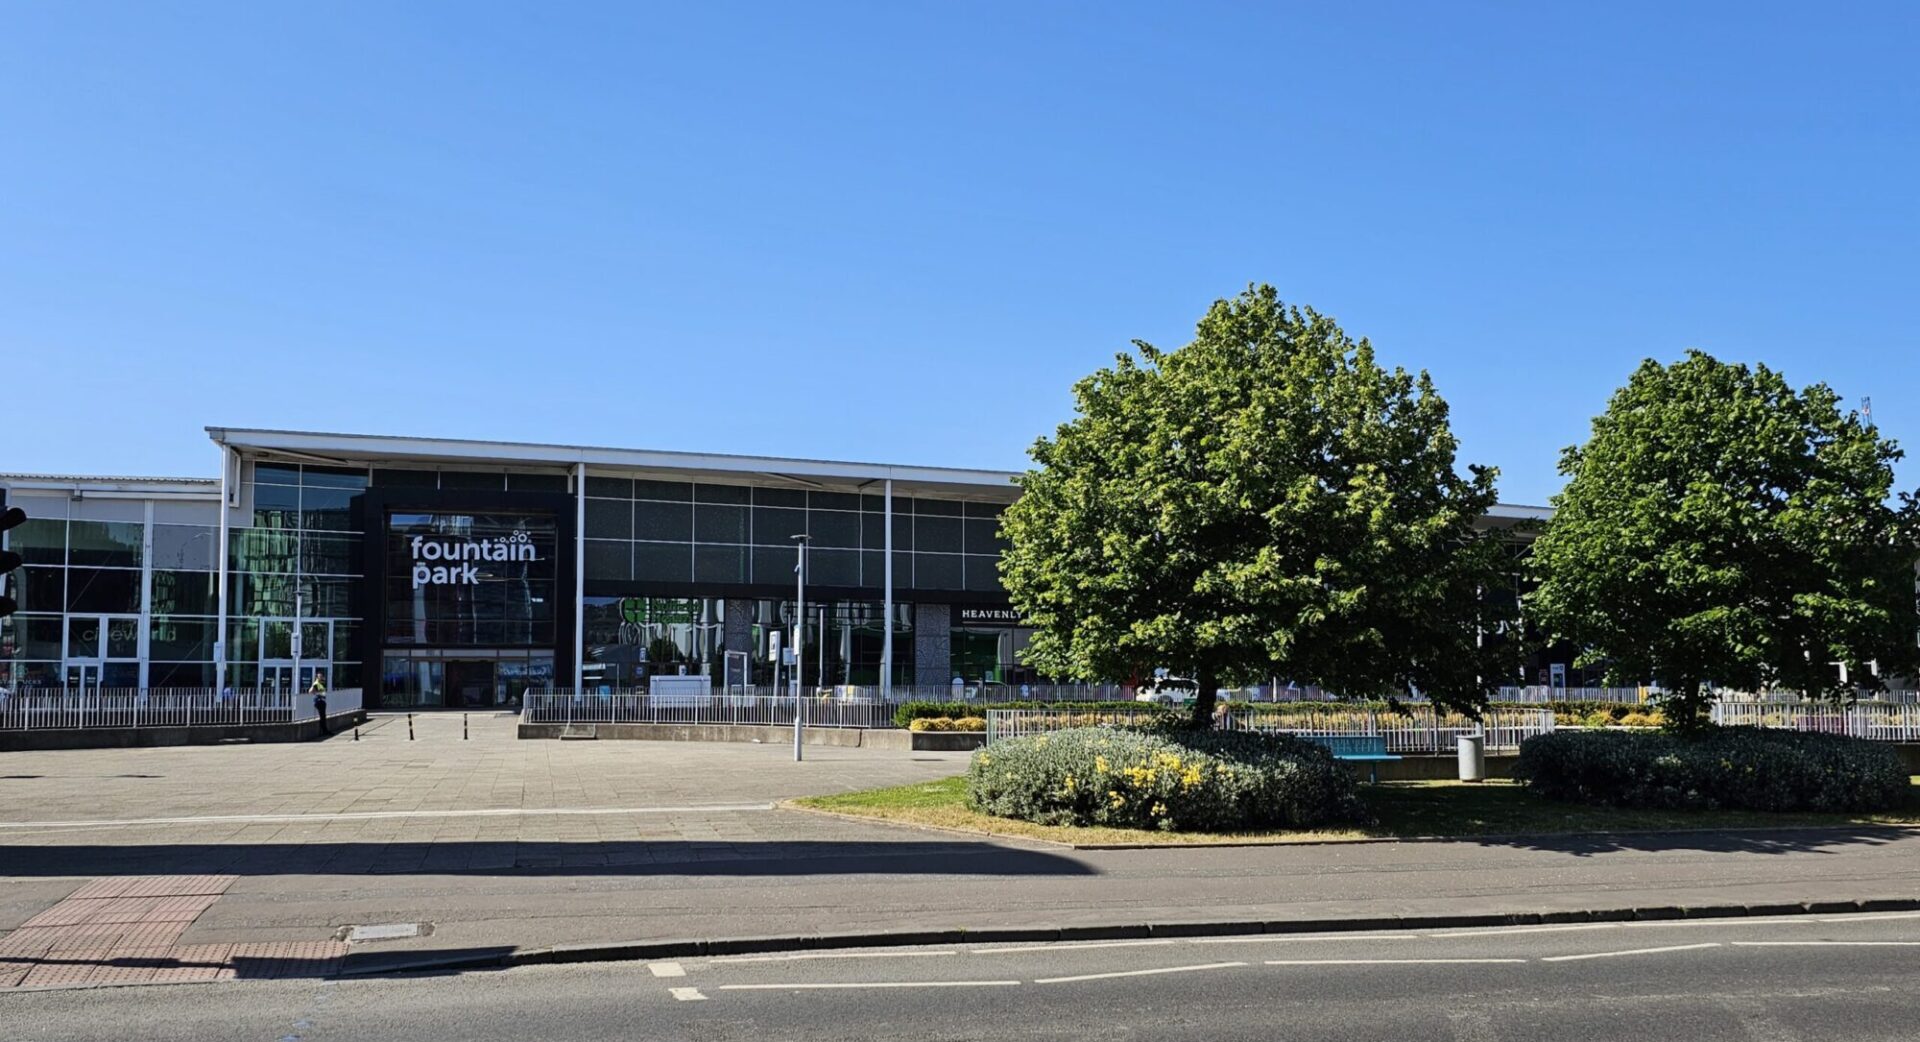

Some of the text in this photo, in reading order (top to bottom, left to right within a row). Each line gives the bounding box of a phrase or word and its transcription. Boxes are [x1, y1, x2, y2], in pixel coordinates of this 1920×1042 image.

[411, 535, 536, 562] fountain
[412, 562, 479, 588] park
[962, 610, 1022, 619] HEAVENLY
